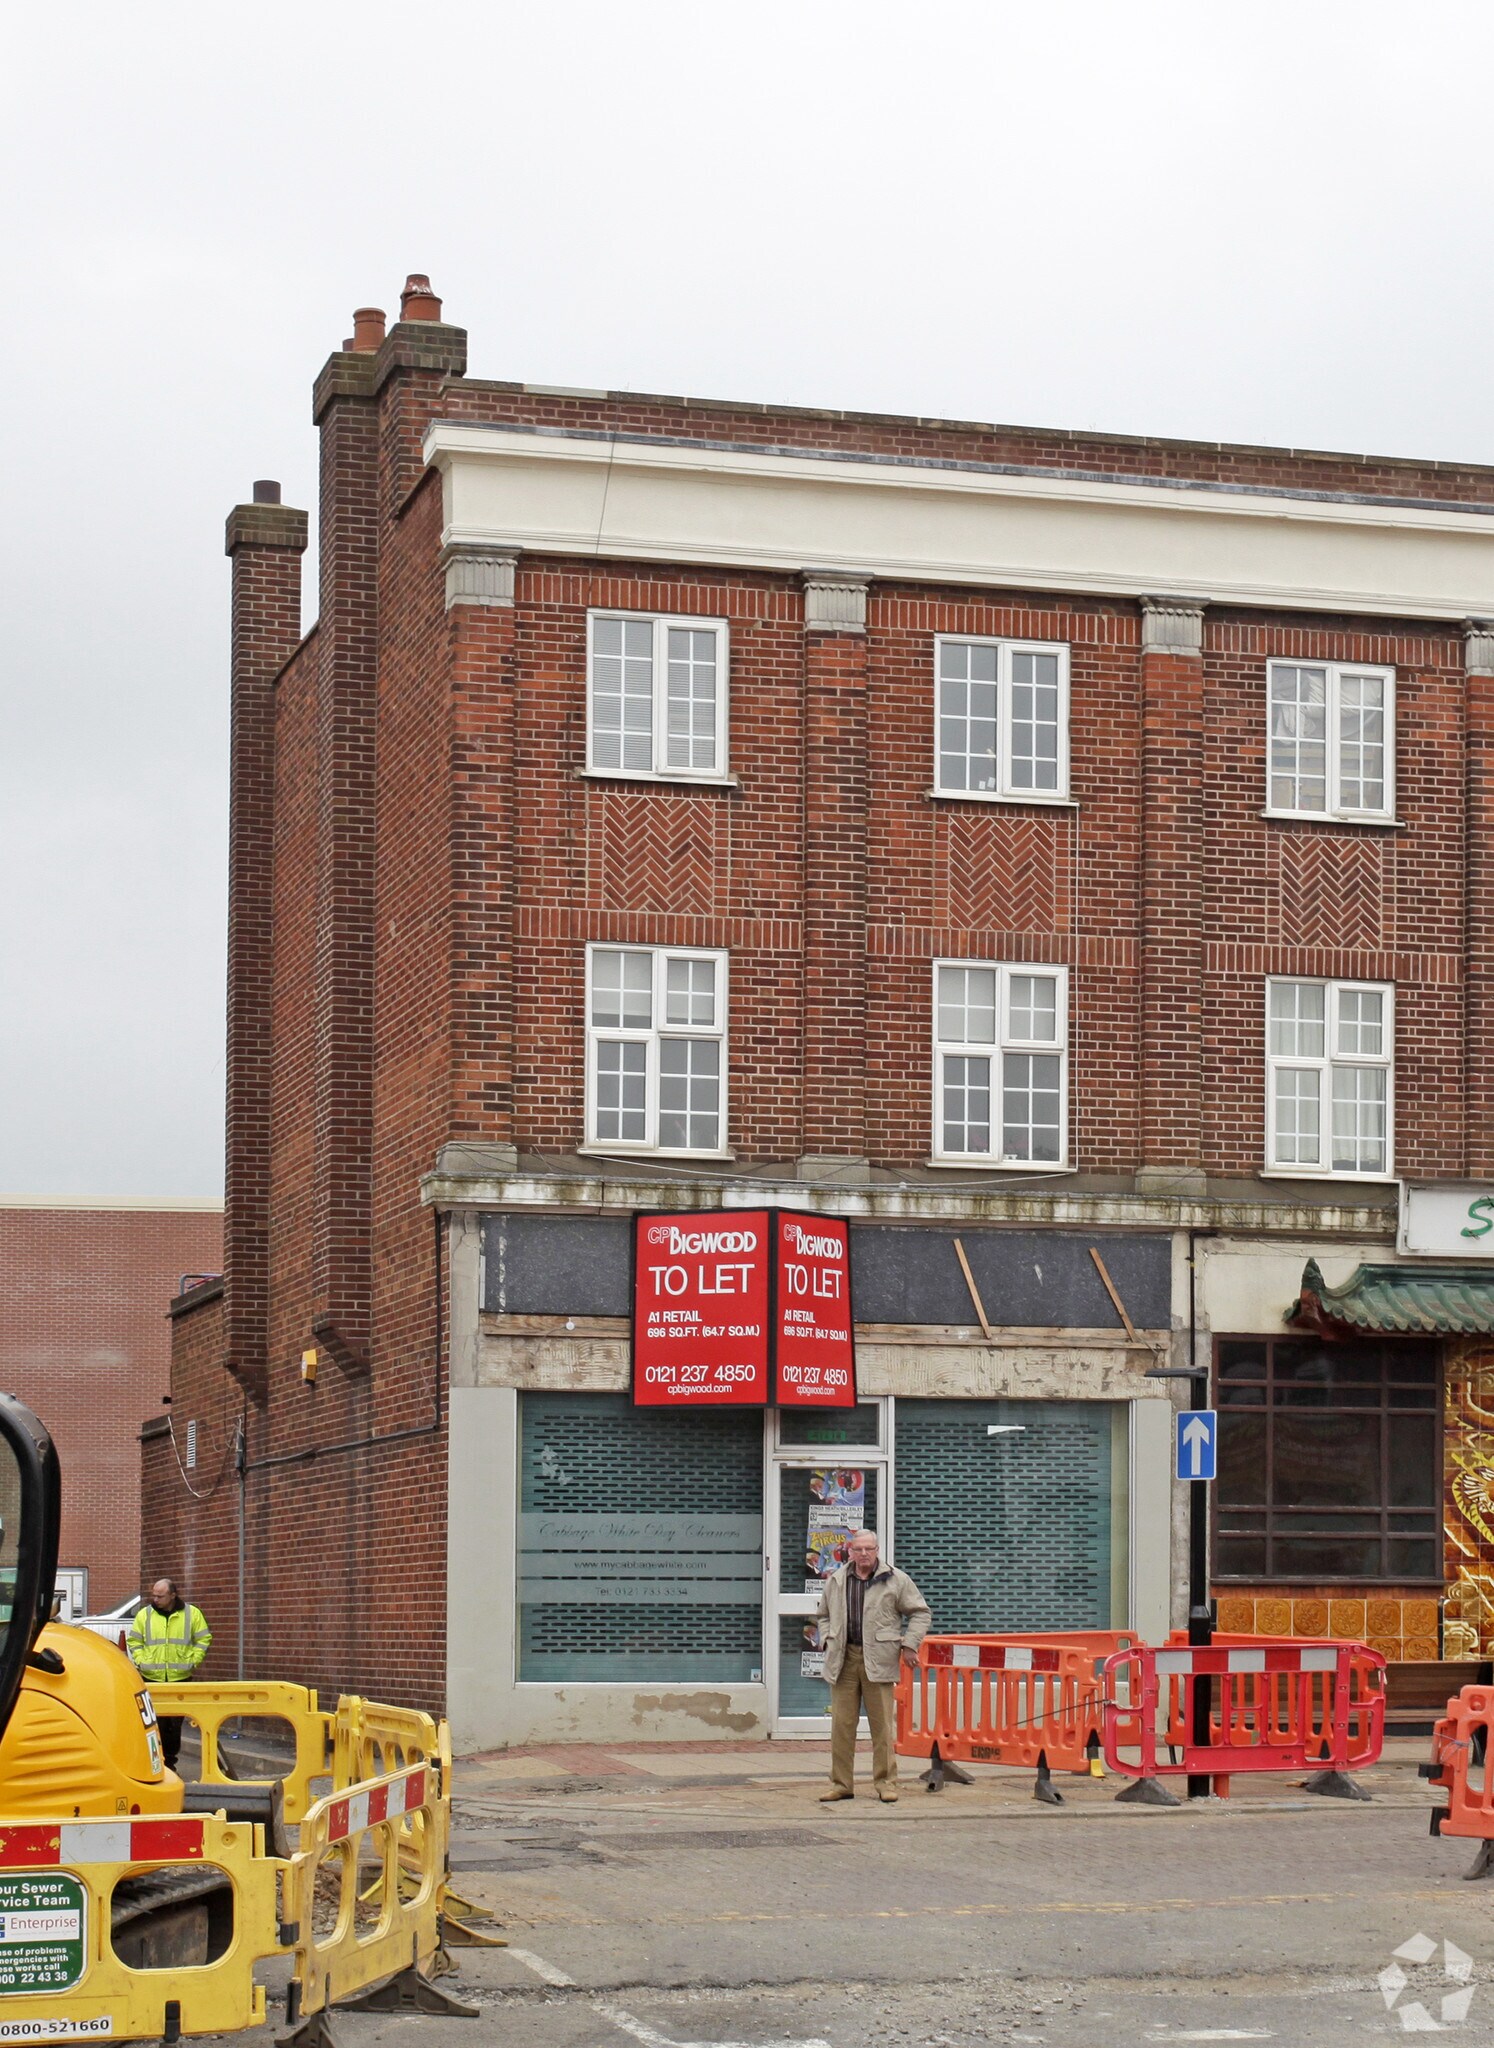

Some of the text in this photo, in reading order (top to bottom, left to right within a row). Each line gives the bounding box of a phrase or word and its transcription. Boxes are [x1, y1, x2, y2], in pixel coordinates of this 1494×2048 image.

[1460, 1198, 1494, 1237] S
[648, 1264, 755, 1296] TO LET
[784, 1263, 843, 1298] TO LET
[648, 1310, 702, 1323] A1 RETAIL
[784, 1309, 816, 1323] A1 RETAIL
[647, 1324, 760, 1337] 696 SQ.FT. (64.7 SQ.M.)
[783, 1326, 795, 1336] 696
[815, 1327, 828, 1340] (64.7
[646, 1365, 756, 1383] 0121 237 4850
[783, 1366, 848, 1386] 0121 237 4850
[668, 1384, 732, 1396] cpbigwood.com
[796, 1385, 836, 1397] cpbigwood.com
[810, 1534, 846, 1551] CIRCUS
[21, 1883, 64, 1894] Sewer
[34, 1895, 71, 1906] Team
[11, 1916, 77, 1931] Enterprise
[14, 1948, 24, 1956] of
[25, 1946, 67, 1958] problems
[50, 1954, 69, 1963] with
[15, 1963, 42, 1972] works
[44, 1962, 61, 1971] call
[0, 1971, 68, 1984] 00 22 43 38
[1, 2019, 109, 2036] 0800-521660
